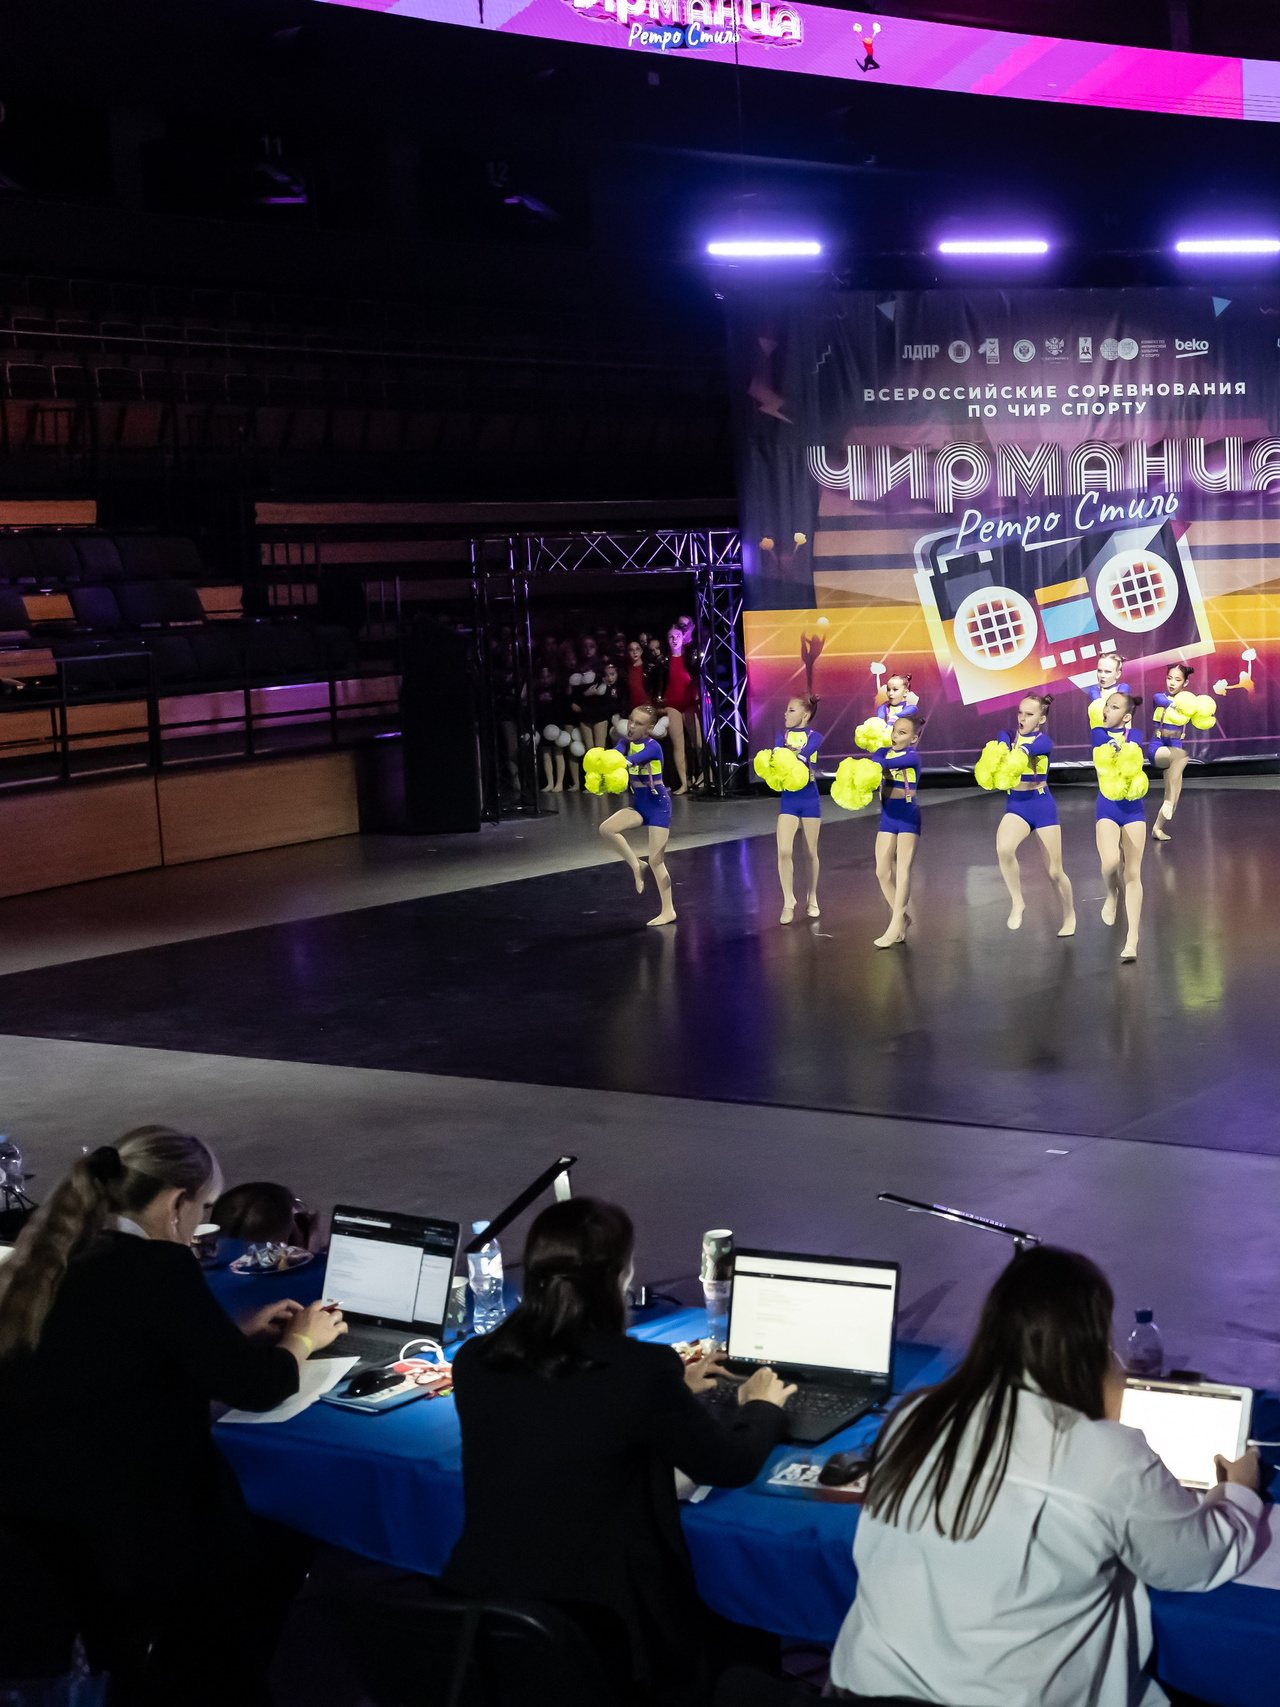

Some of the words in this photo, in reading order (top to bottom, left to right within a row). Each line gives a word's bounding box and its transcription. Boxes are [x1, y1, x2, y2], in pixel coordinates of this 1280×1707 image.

[628, 22, 682, 50] Ретро
[687, 22, 740, 46] Стиль
[902, 344, 940, 361] ЛДПР
[1175, 338, 1209, 351] beko
[863, 383, 1058, 402] ВСЕРОССИЙСКИЕ
[1067, 381, 1247, 398] СОРЕВНОВАНИЯ
[968, 404, 998, 418] ПО
[1008, 403, 1052, 418] ЧИР
[1061, 401, 1148, 417] СПОРТУ
[955, 508, 1061, 550] Ретро
[1074, 490, 1180, 530] Стиль
